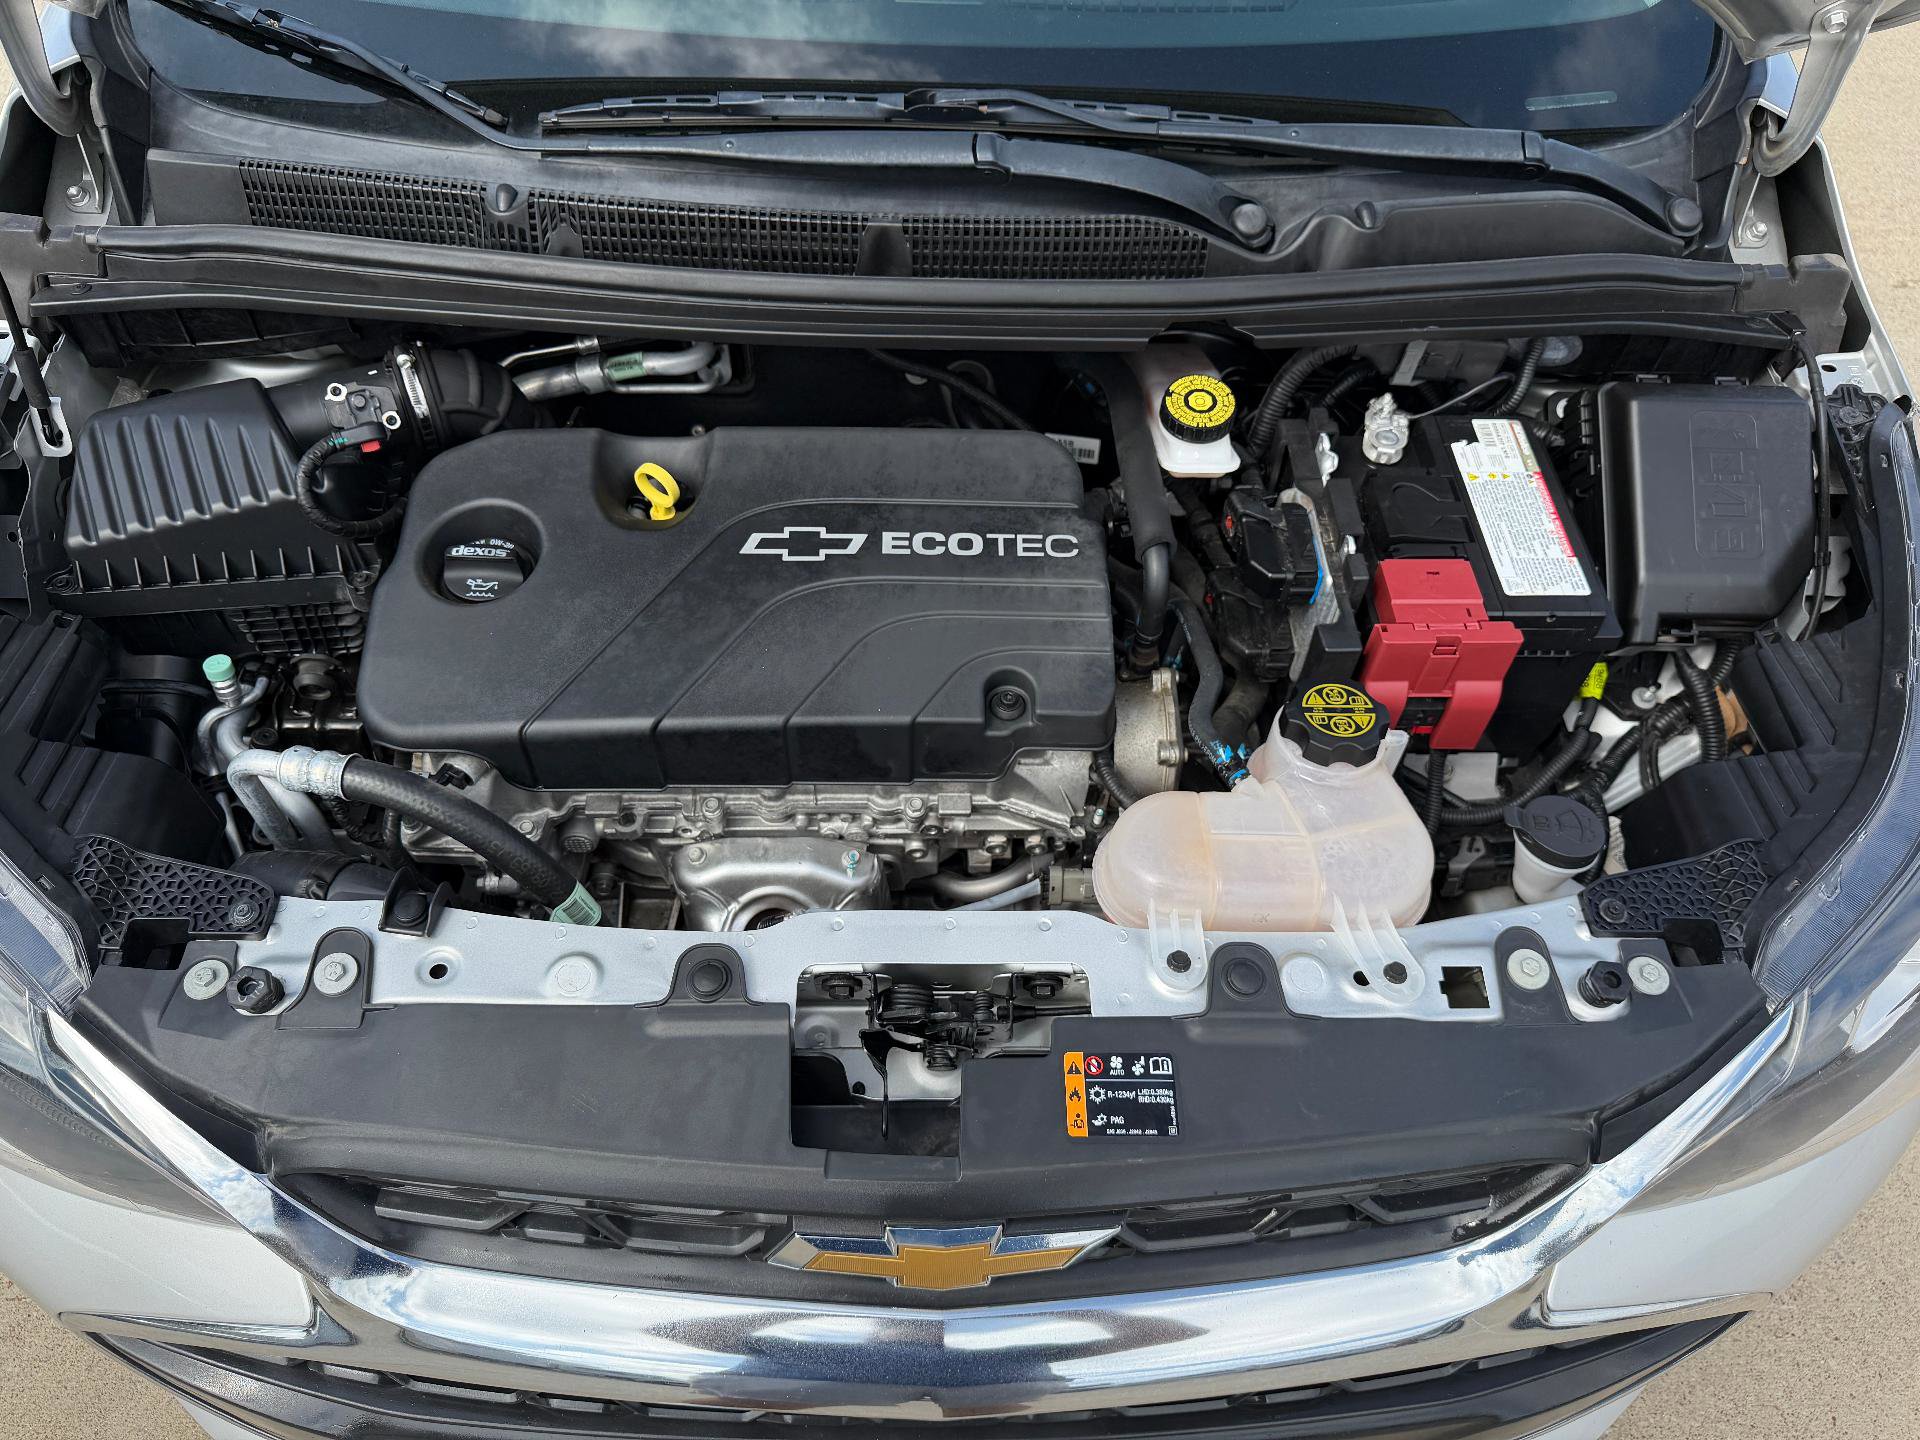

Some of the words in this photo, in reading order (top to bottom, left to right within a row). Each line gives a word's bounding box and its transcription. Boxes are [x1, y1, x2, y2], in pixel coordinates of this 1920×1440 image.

[451, 544, 508, 557] dexos
[881, 531, 1080, 558] ECOTEC
[1110, 1115, 1125, 1124] PAG
